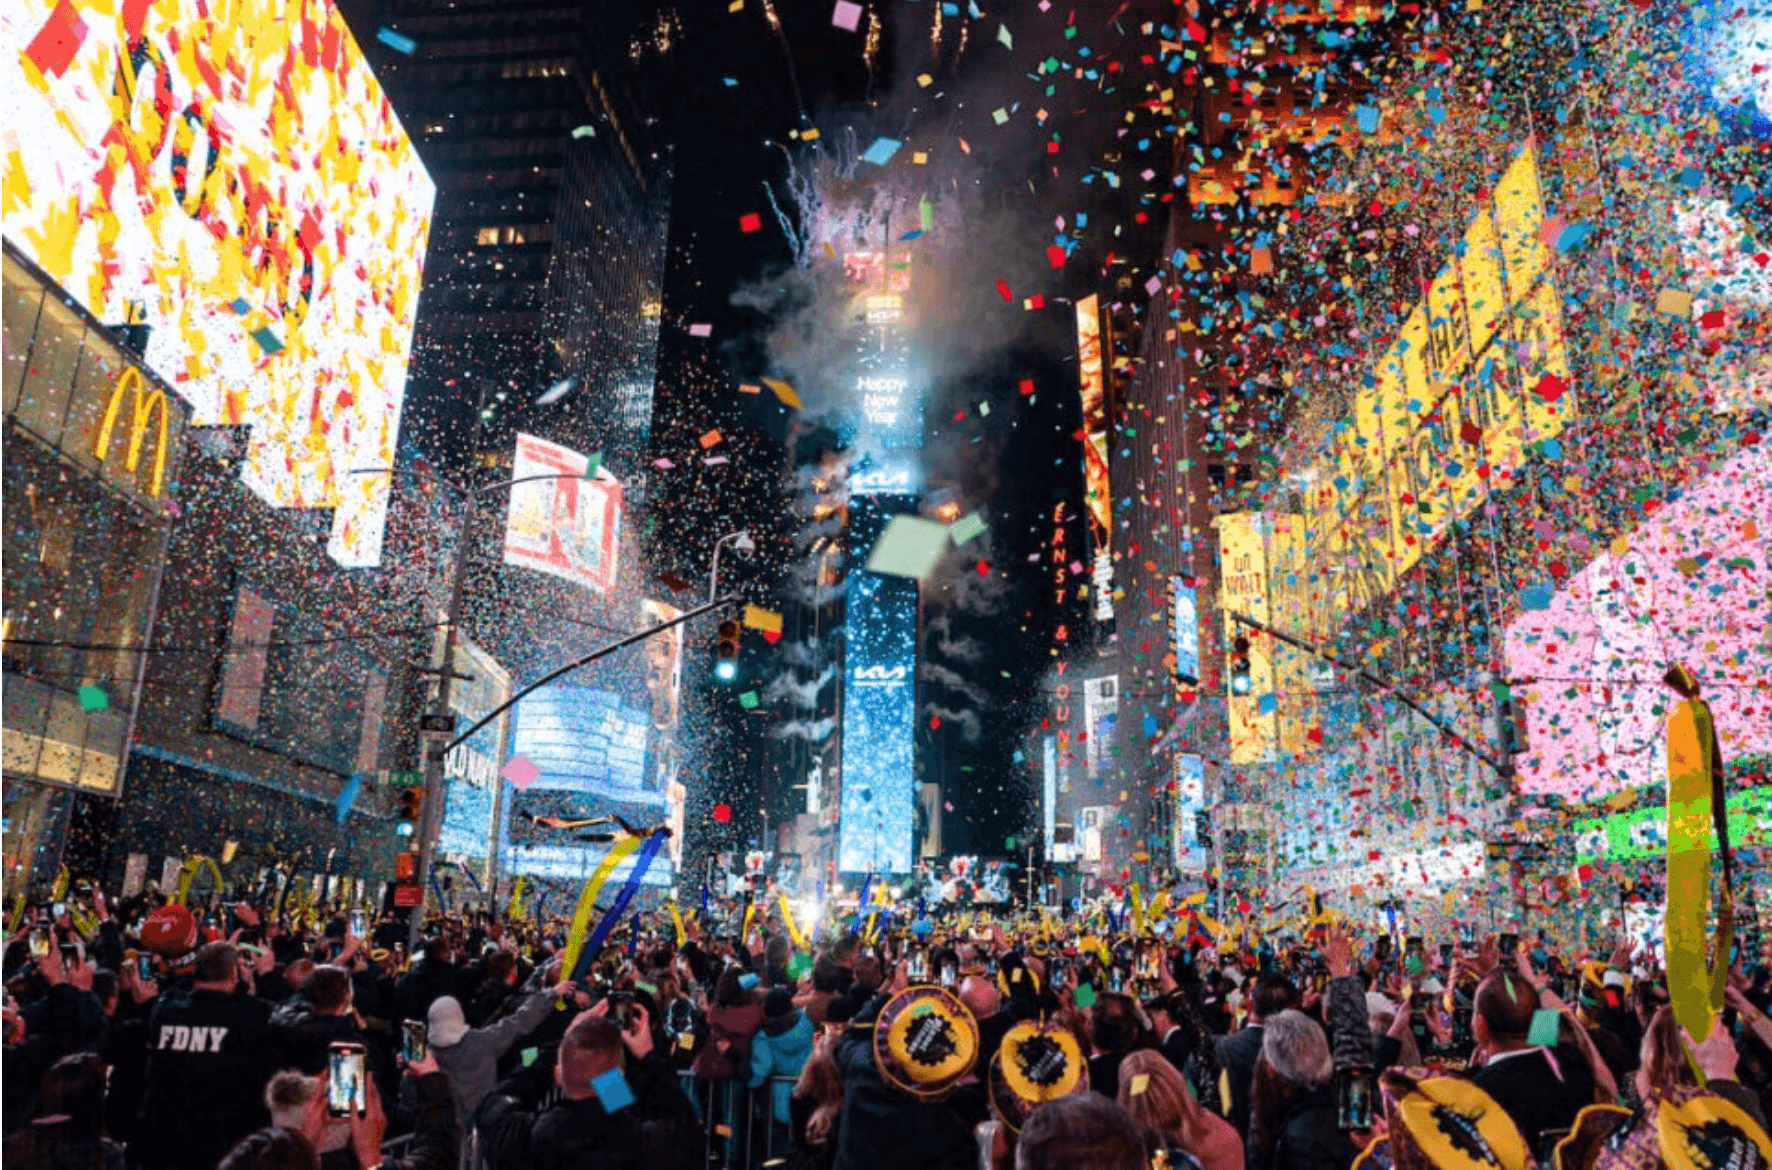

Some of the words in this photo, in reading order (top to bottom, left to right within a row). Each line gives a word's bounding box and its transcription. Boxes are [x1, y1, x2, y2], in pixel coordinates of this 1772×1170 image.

[855, 376, 907, 393] Happy
[864, 394, 898, 407] New
[865, 409, 897, 424] Year
[1052, 504, 1067, 604] ERNST
[1055, 624, 1069, 640] &
[157, 1025, 229, 1052] FDNY
